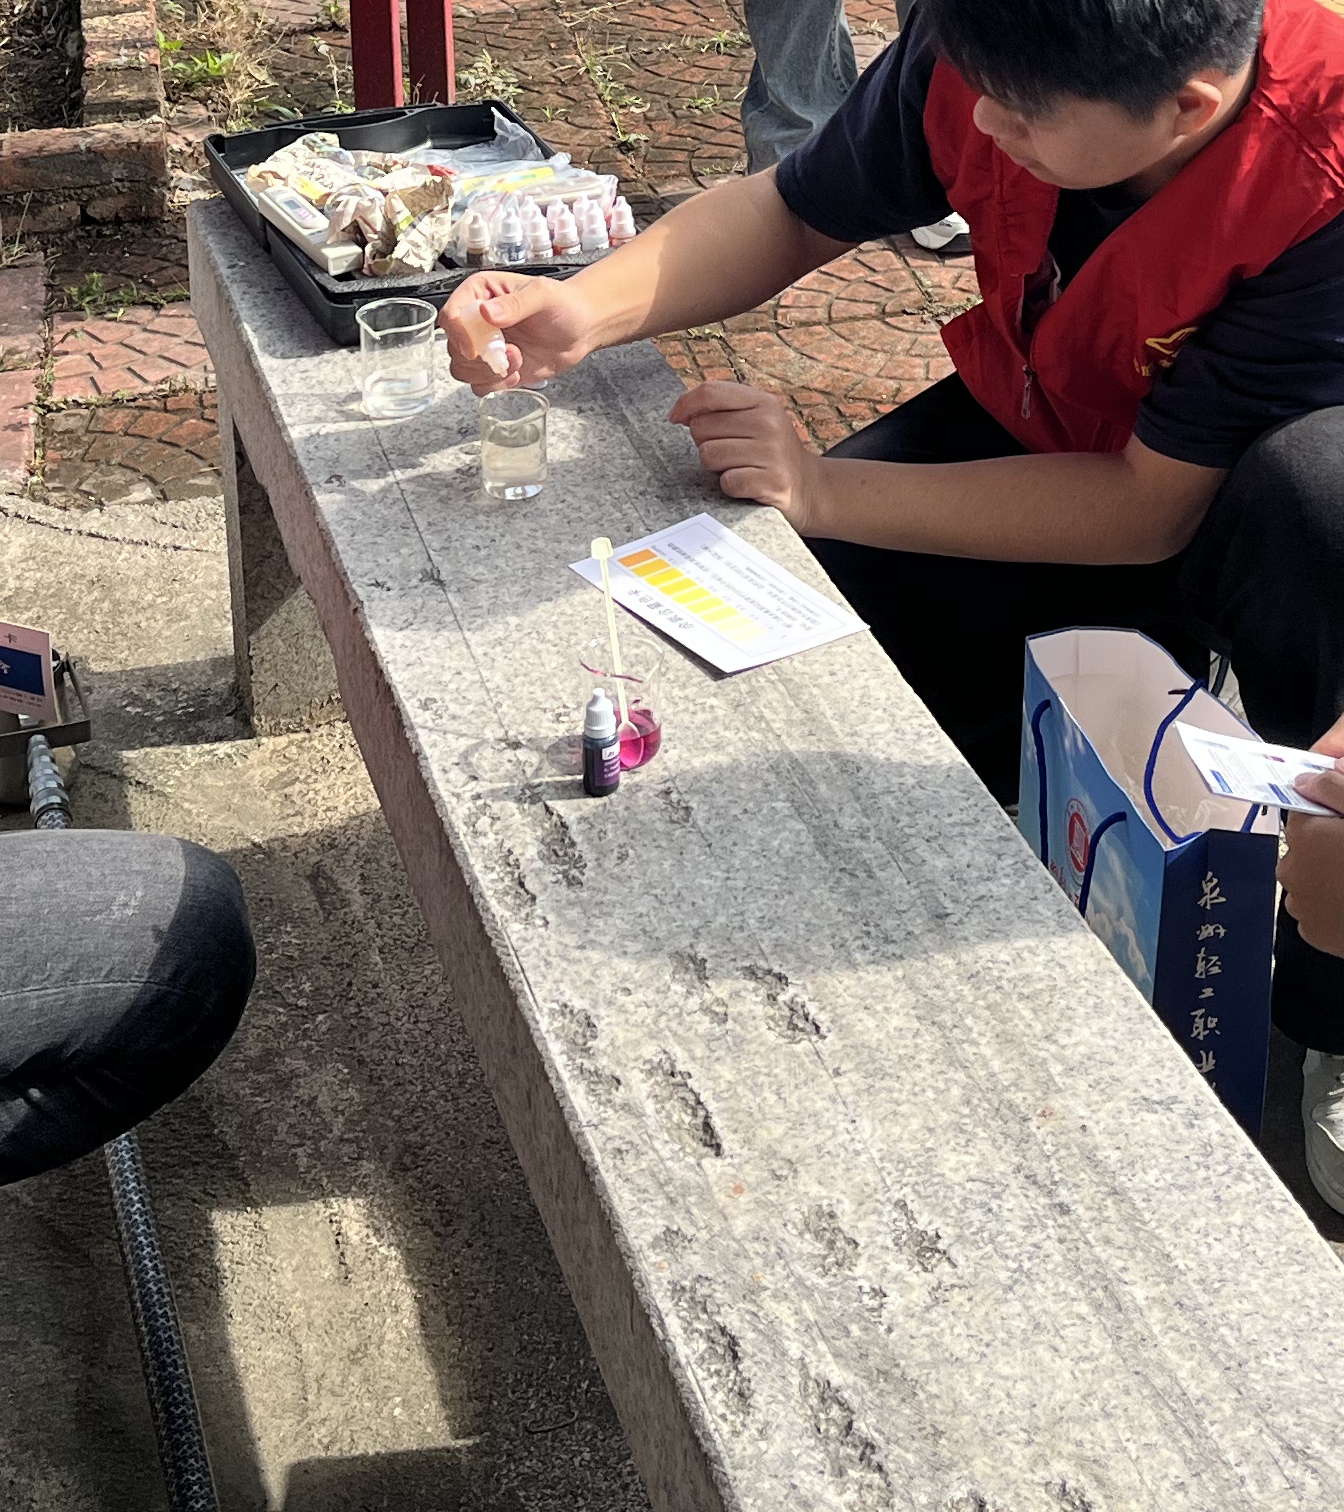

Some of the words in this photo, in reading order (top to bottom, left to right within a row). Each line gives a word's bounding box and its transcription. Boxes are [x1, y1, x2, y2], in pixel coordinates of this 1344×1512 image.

[1190, 871, 1228, 1088] 泉州轻工职业
